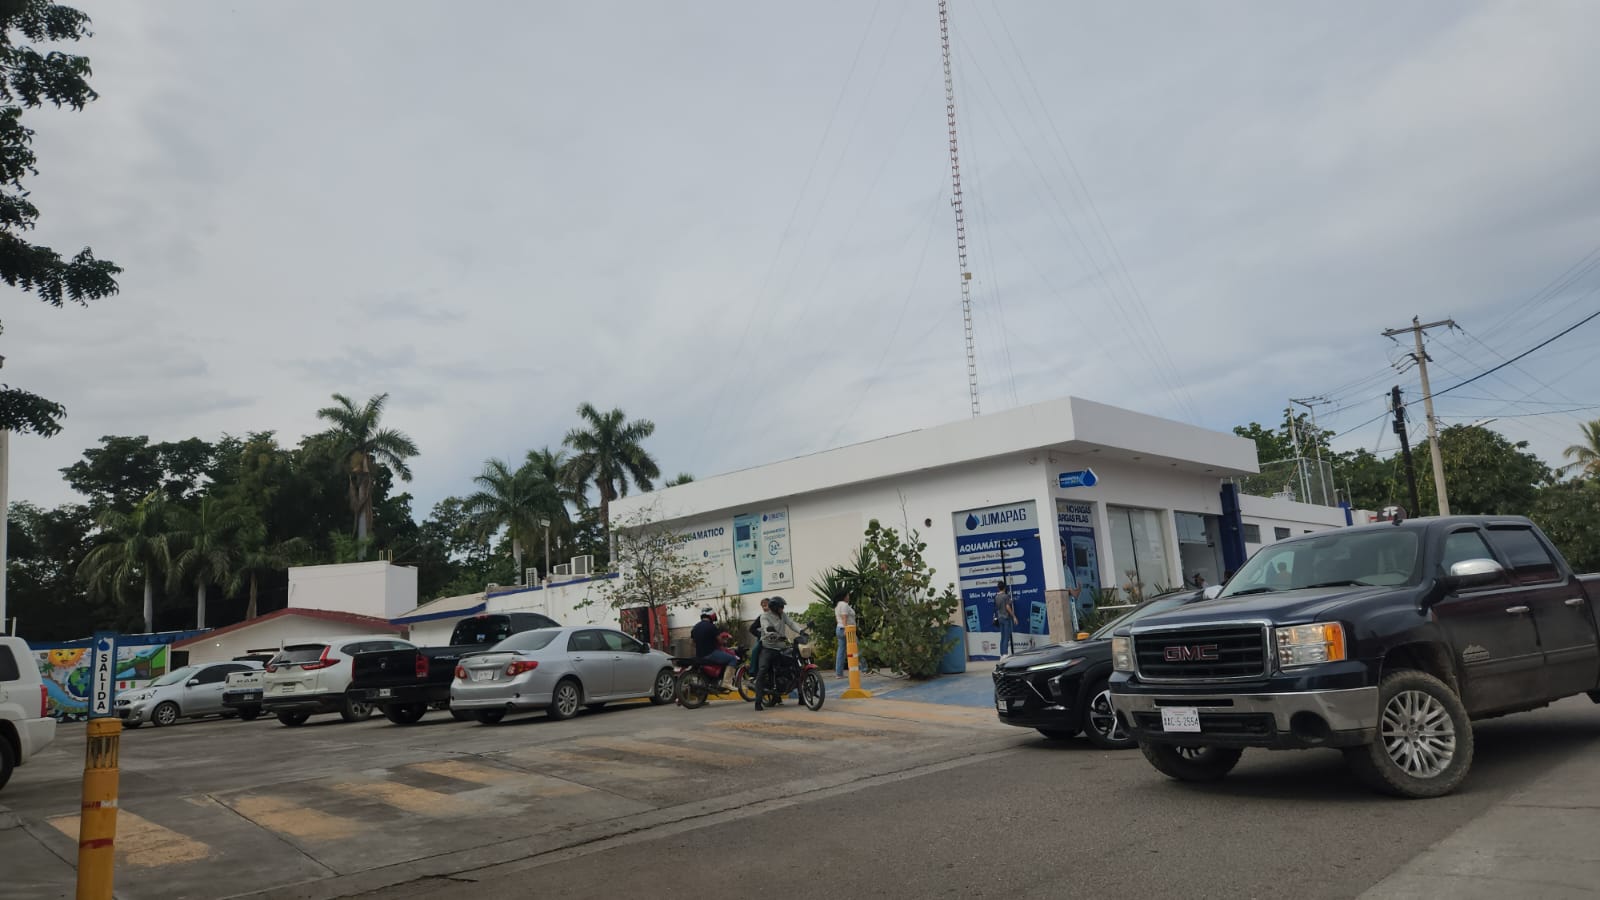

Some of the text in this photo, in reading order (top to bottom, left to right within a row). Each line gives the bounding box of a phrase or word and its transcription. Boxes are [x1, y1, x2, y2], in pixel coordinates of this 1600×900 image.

[980, 508, 1027, 527] JUMAPAG
[1058, 513, 1076, 523] ARGAS
[1164, 644, 1218, 661] GMC
[97, 654, 107, 710] SALIDA
